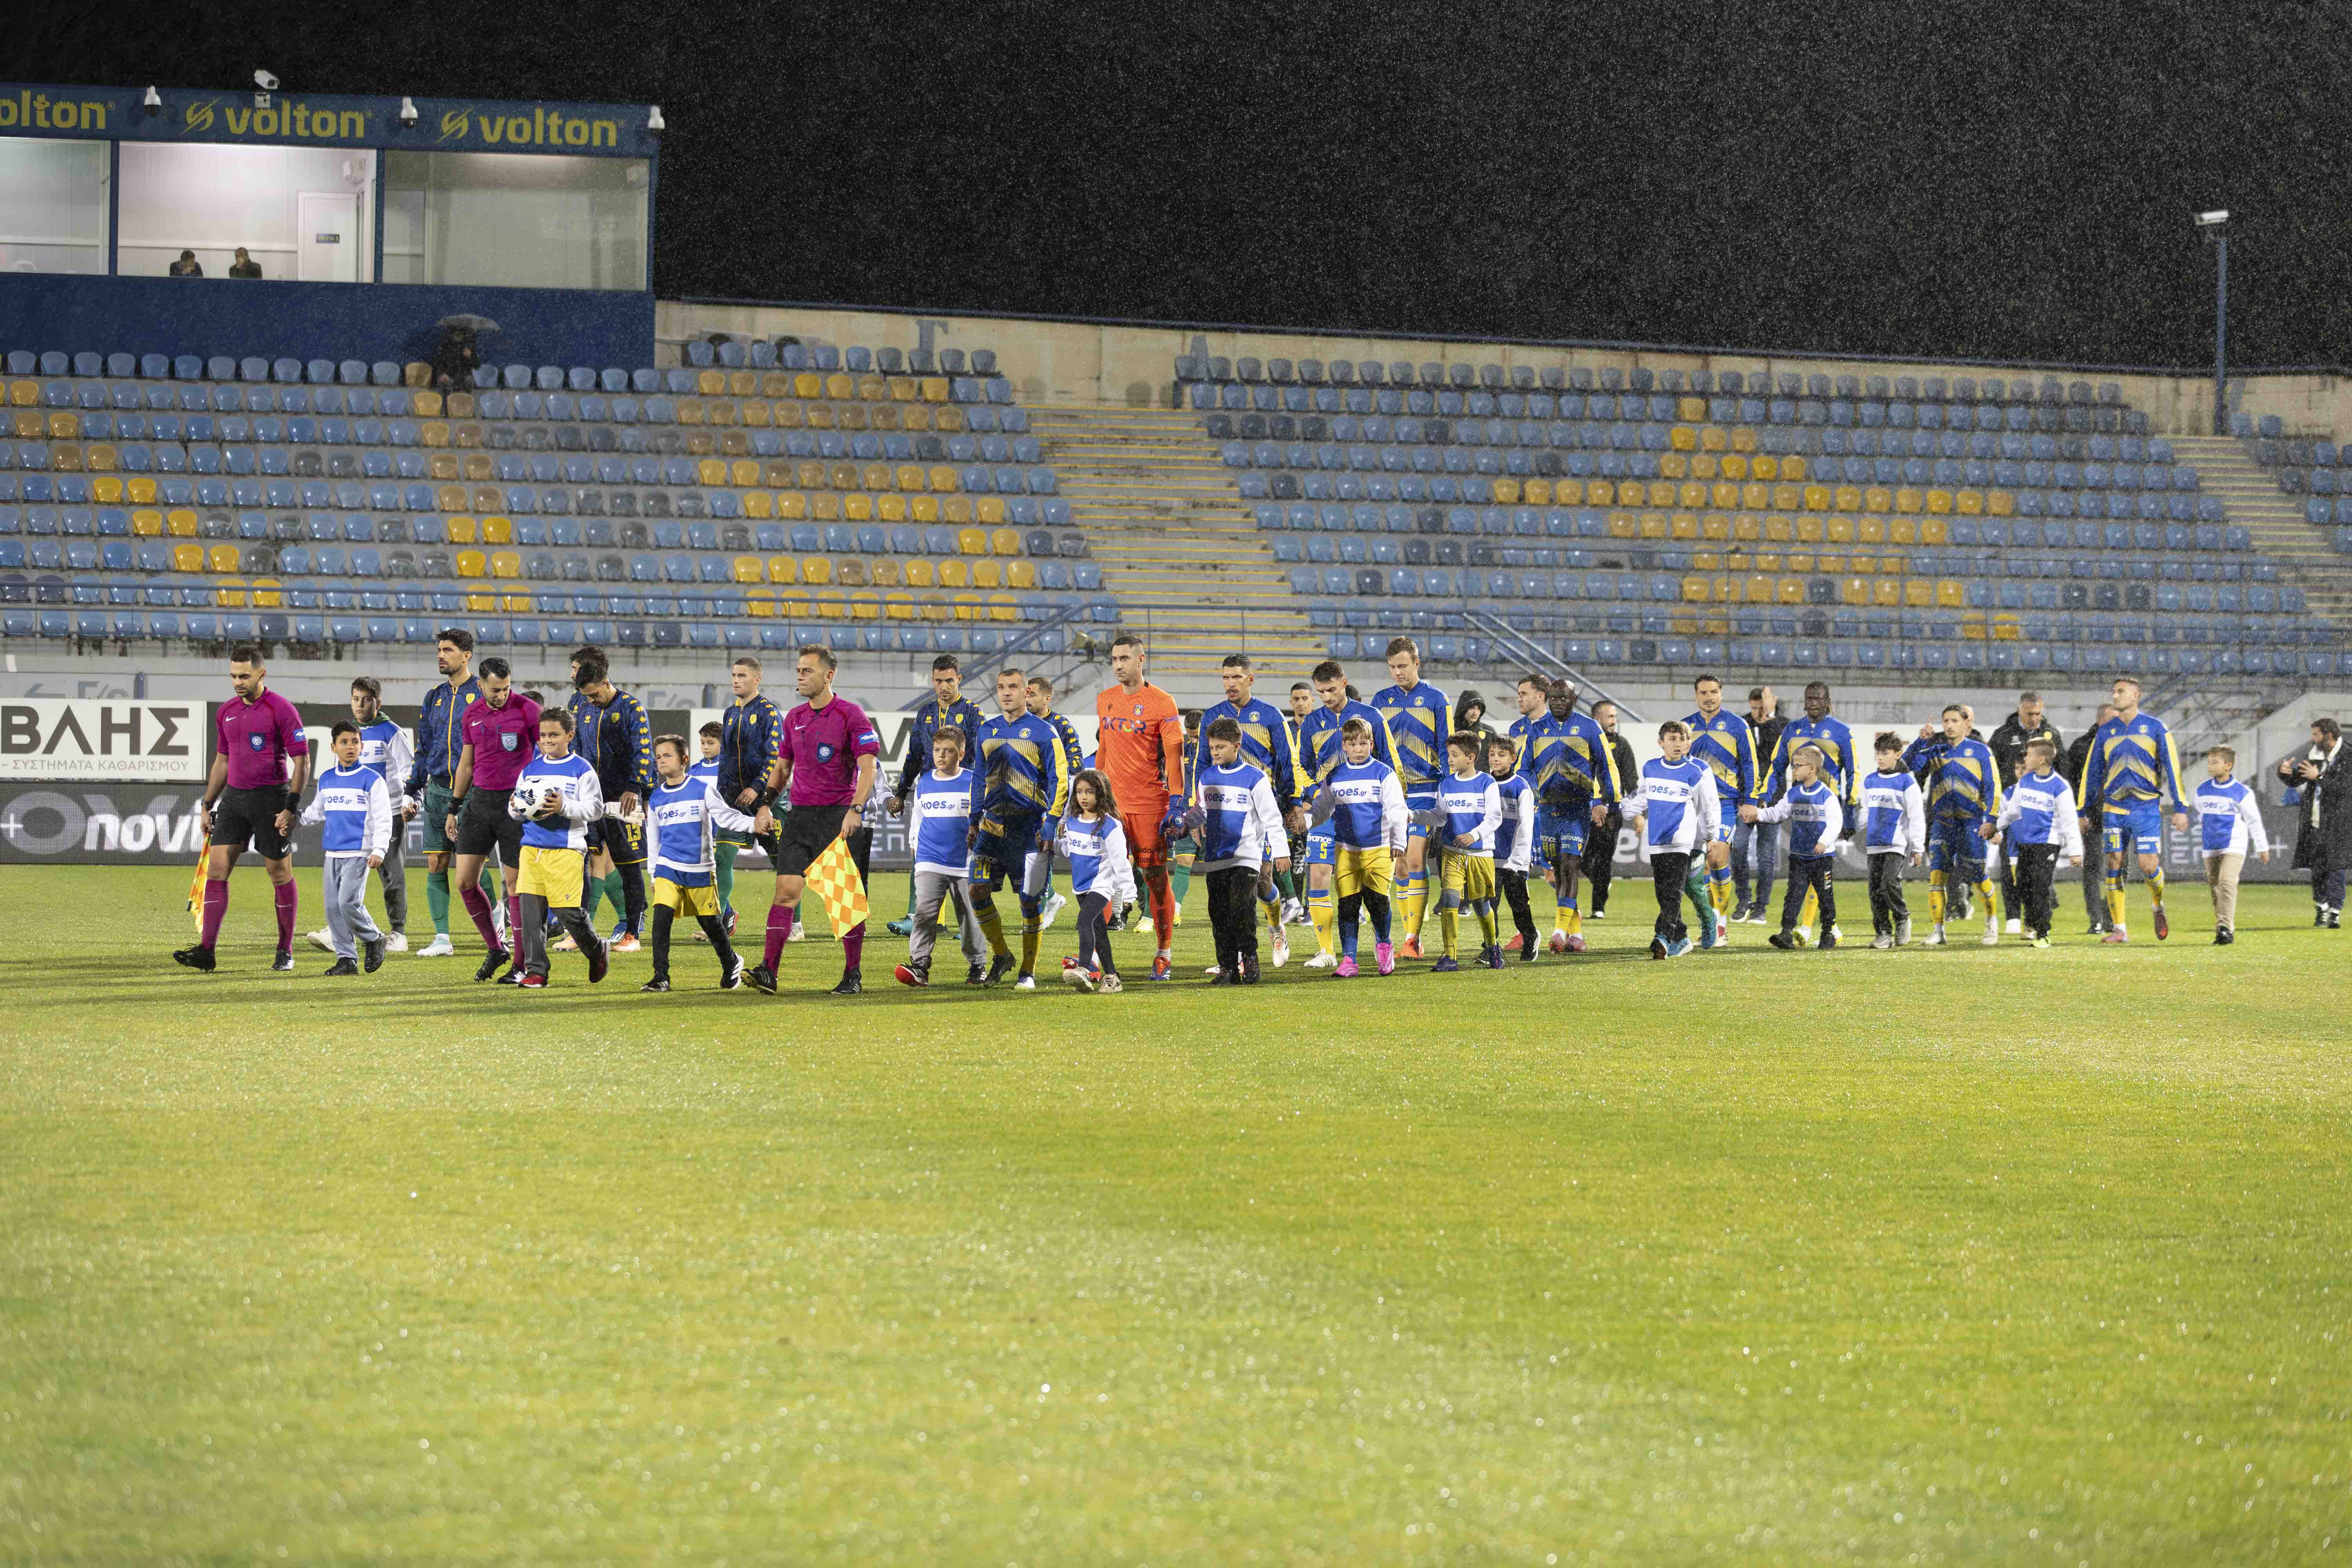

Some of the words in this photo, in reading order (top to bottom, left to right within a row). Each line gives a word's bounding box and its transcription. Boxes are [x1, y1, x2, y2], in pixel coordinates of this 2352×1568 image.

[225, 99, 364, 138] volton
[477, 107, 617, 147] volton
[12, 759, 94, 771] ΣΥΣΤΗΜΑΤΑ
[98, 761, 189, 771] ΚΑΘΑΡΙΣΜΟΥ
[626, 824, 641, 842] 13
[1320, 842, 1327, 859] 5
